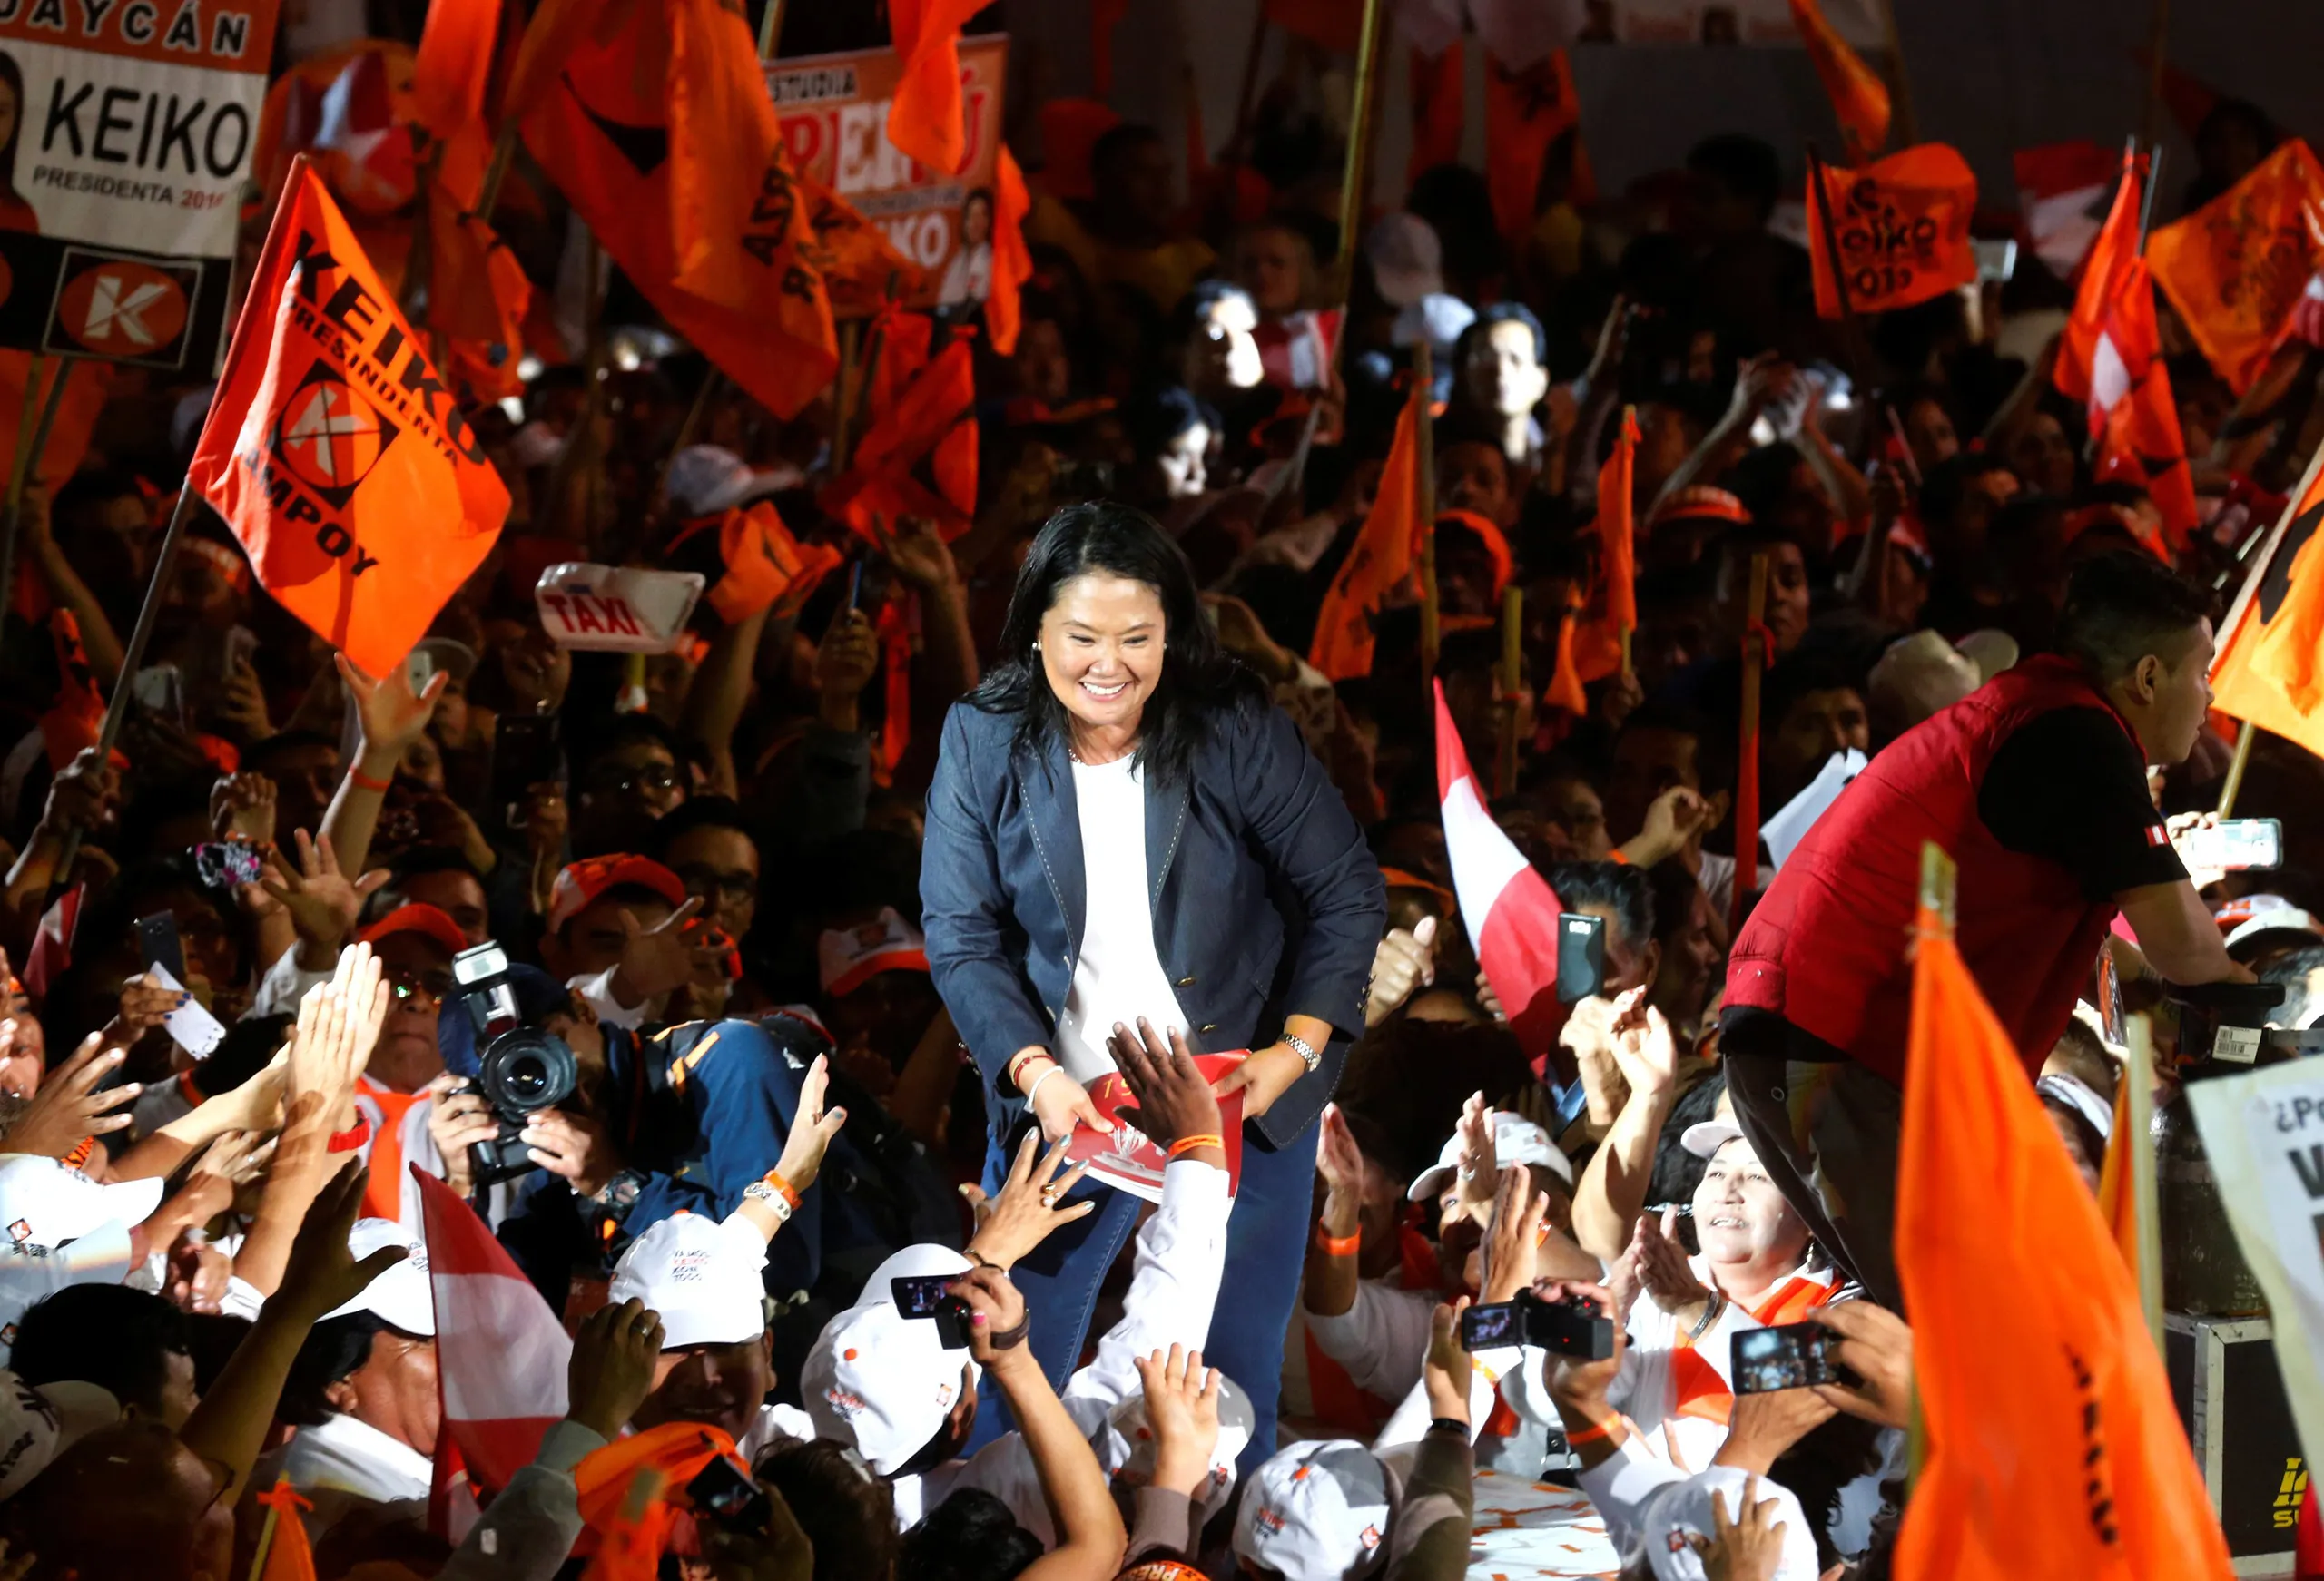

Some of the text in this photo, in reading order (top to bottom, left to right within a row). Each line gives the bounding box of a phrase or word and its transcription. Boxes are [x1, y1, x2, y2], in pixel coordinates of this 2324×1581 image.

[42, 77, 250, 178] KEIKO
[33, 165, 173, 204] PRESIDENTA
[83, 275, 170, 345] K
[300, 230, 487, 466] KEIKO
[243, 451, 379, 579] AMPOY
[542, 594, 642, 635] TAXI
